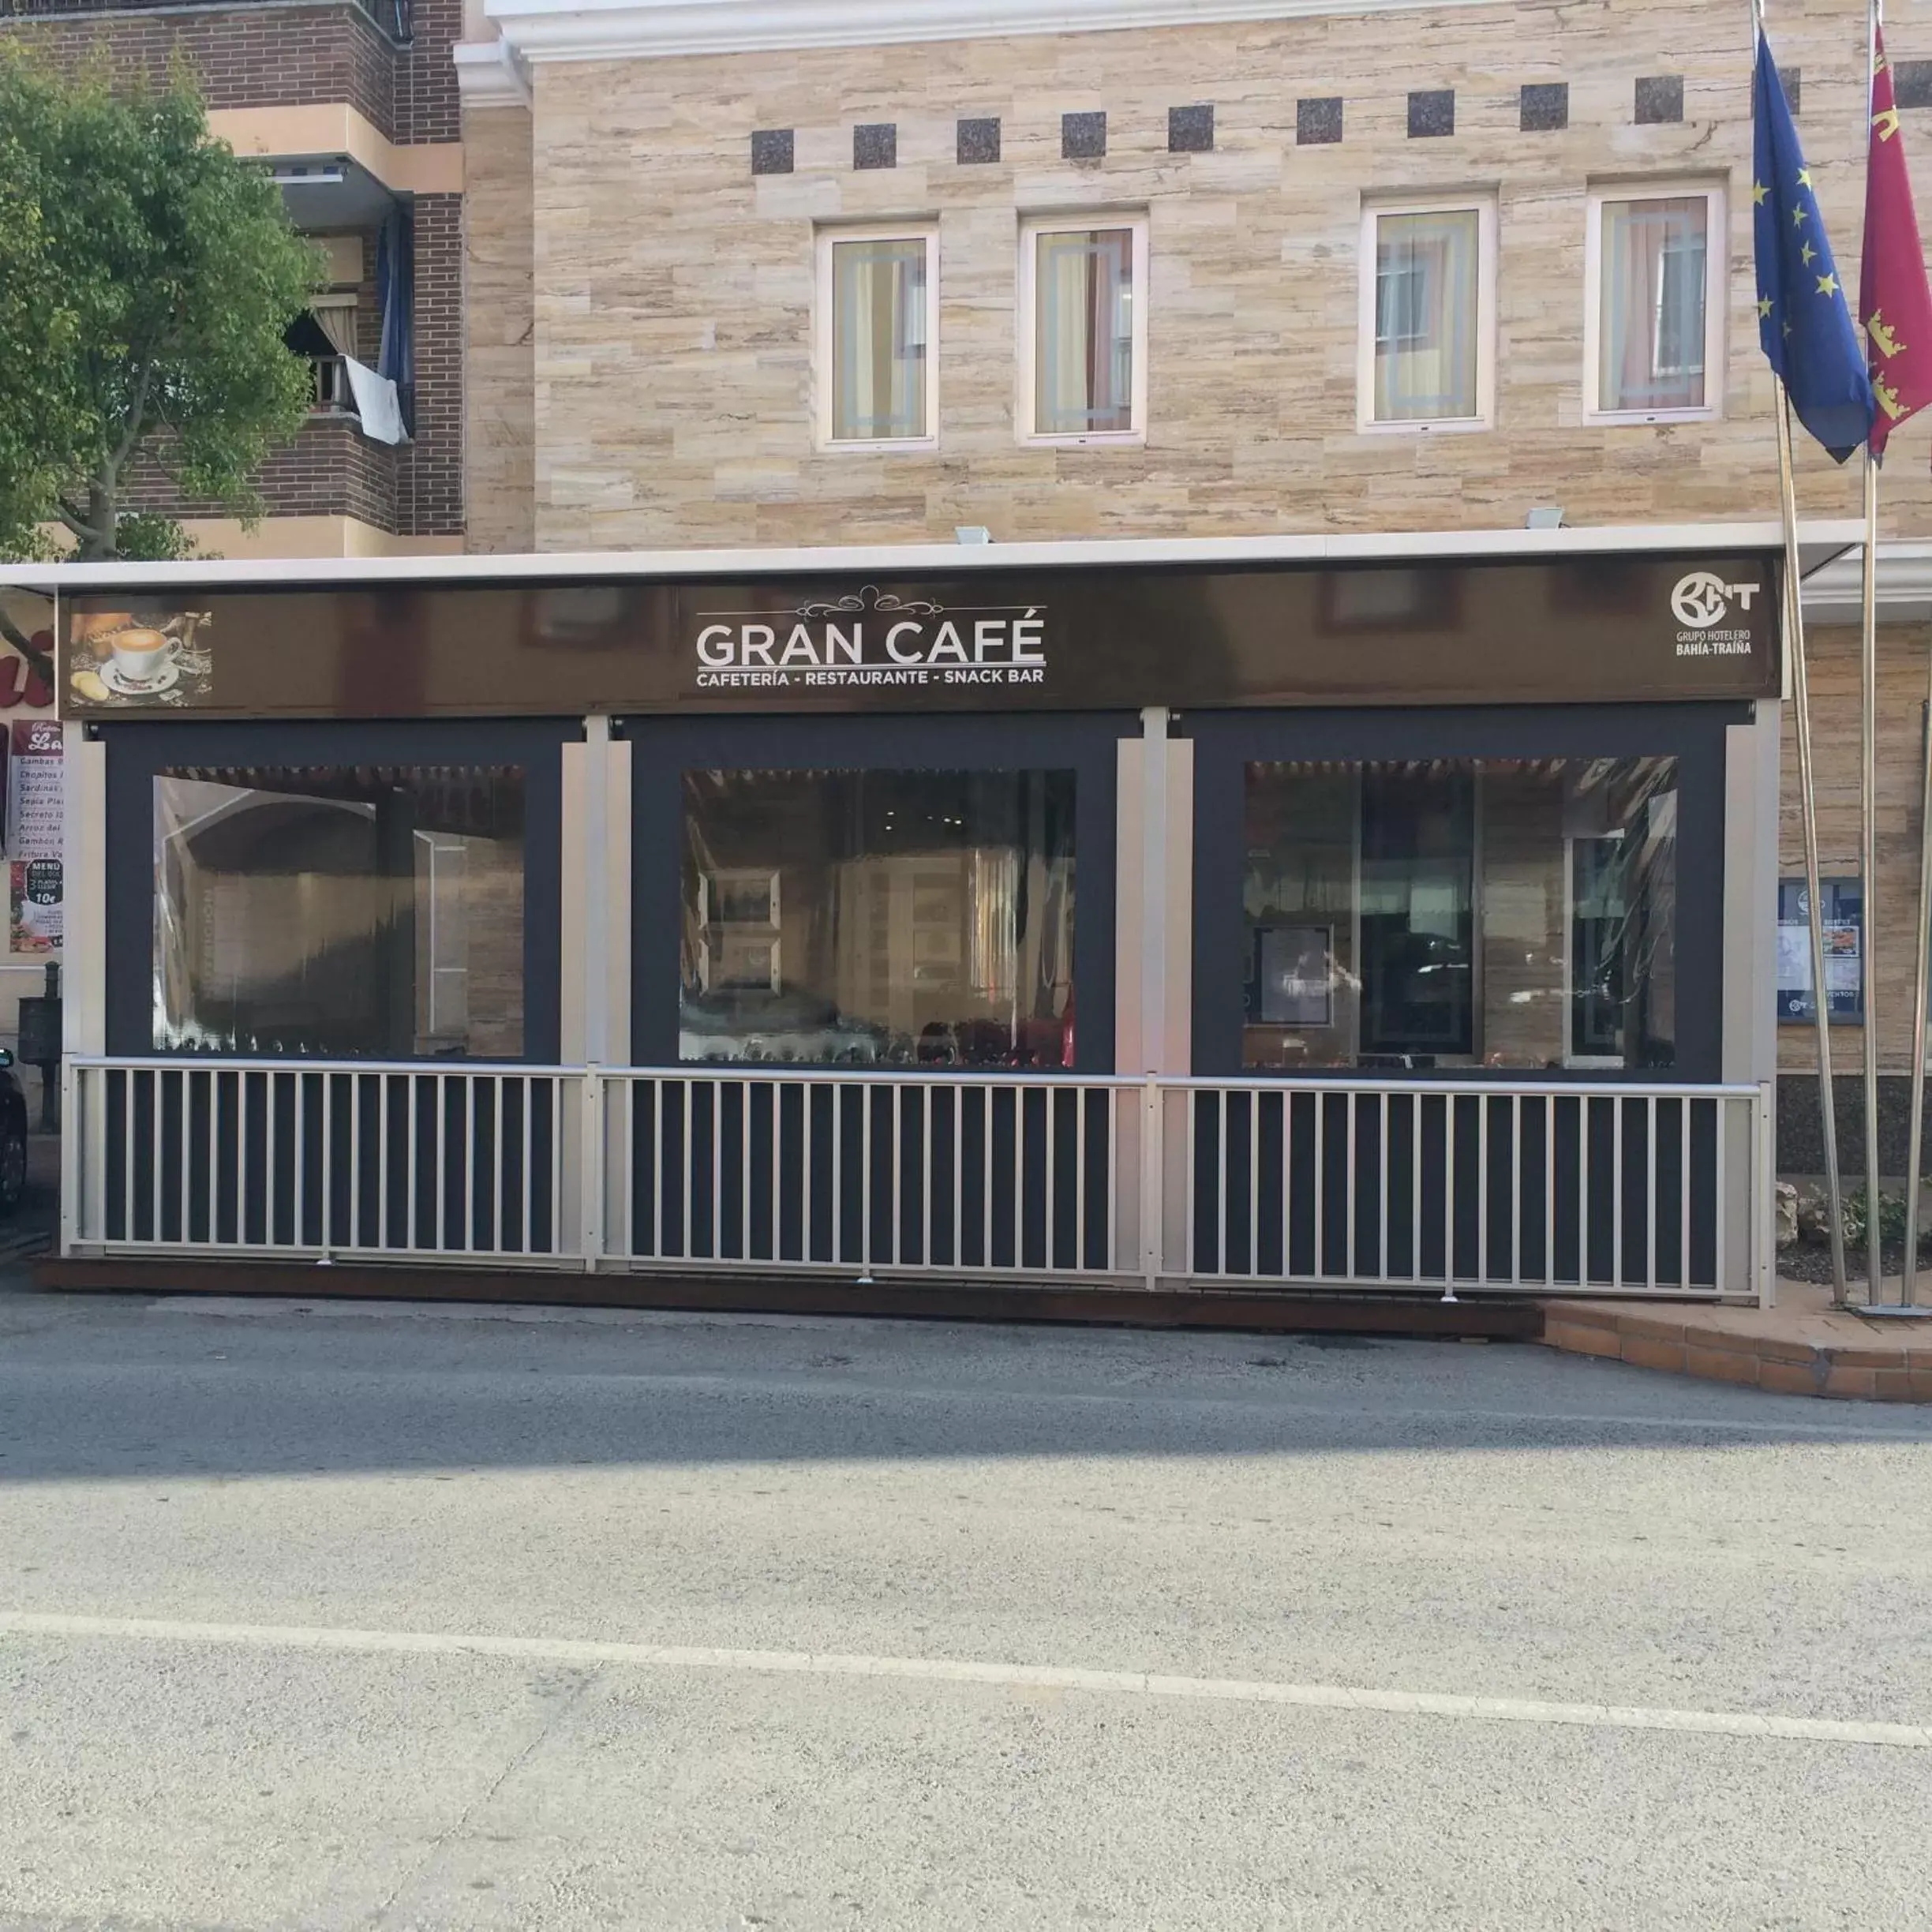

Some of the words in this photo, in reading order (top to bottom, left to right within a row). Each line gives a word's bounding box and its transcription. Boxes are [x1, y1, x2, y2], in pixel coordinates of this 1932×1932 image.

[696, 623, 863, 666] GRAN
[886, 607, 1045, 665] CAFÉ
[1676, 631, 1705, 642] GRUPO
[1707, 630, 1750, 640] HOTELERO
[696, 669, 789, 687] CAFETERÍA
[806, 670, 928, 686] RESTAURANTE
[944, 669, 1003, 683] SNACK
[1008, 669, 1044, 683] BAR
